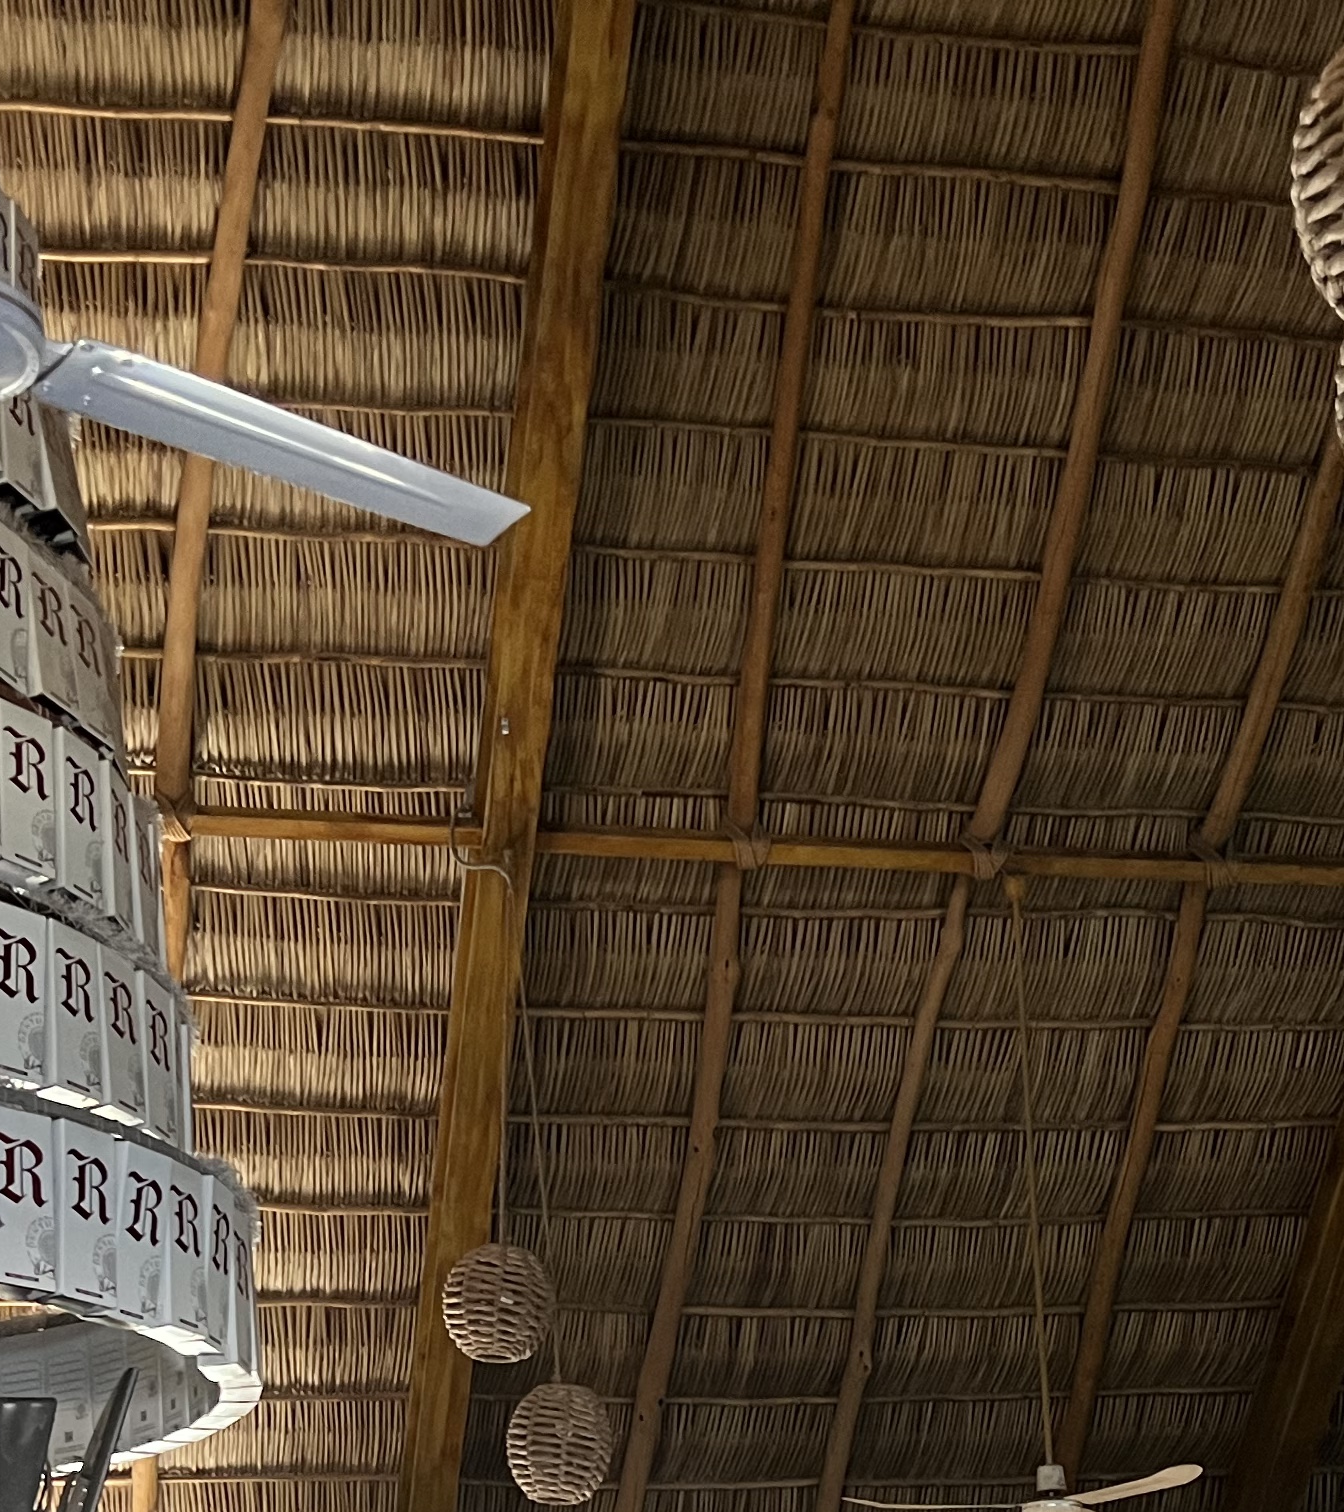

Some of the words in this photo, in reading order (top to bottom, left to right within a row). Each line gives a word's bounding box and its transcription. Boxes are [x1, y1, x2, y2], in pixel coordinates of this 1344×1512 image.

[31, 571, 67, 646] R
[71, 604, 101, 677] R
[3, 725, 49, 801] R
[66, 756, 96, 832] R
[57, 947, 94, 1023] R
[104, 971, 136, 1044] R
[146, 1000, 169, 1071] R
[67, 1148, 110, 1225] R
[125, 1171, 163, 1246] R
[171, 1184, 201, 1257] R
[212, 1203, 230, 1275] R
